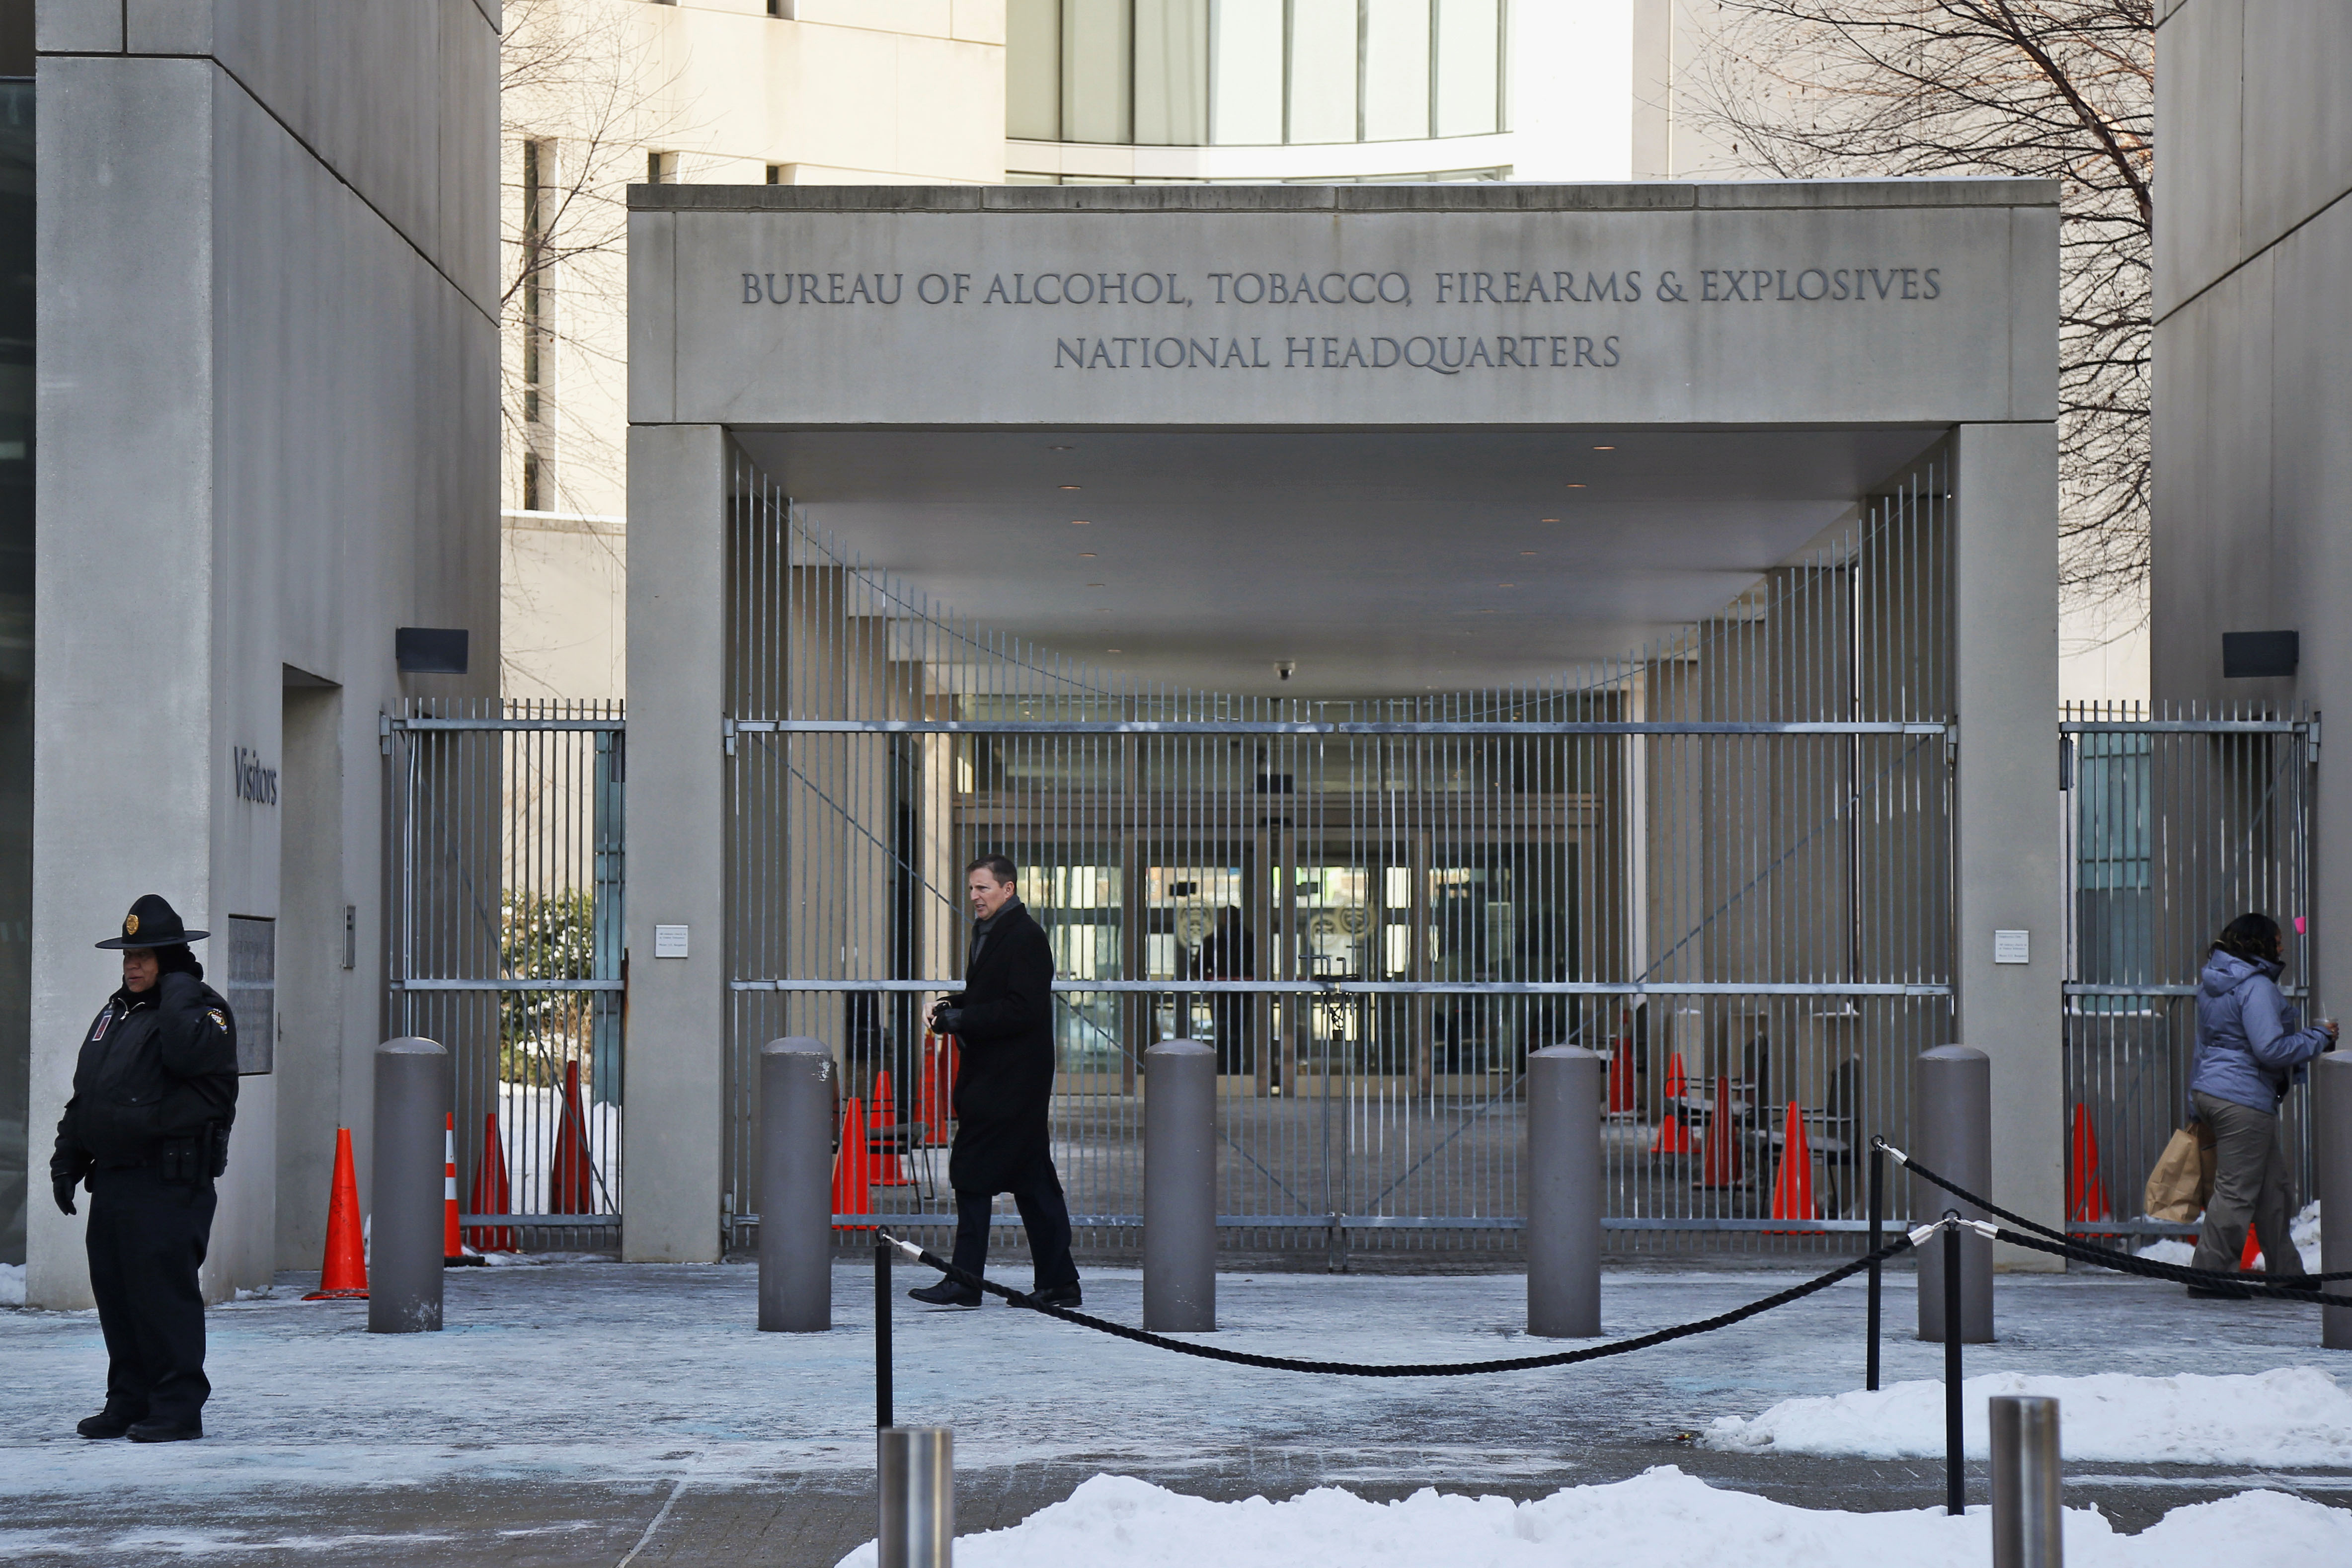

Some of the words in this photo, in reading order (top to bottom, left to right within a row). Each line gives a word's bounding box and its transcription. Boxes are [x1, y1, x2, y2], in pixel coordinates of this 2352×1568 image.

[741, 272, 904, 306] BUREAU
[917, 273, 972, 305] OF
[982, 272, 1194, 309] ALCOHOL,
[1207, 271, 1413, 308] TOBACCO,
[1434, 270, 1642, 305] FIREARMS
[1656, 270, 1689, 304] &
[1699, 267, 1941, 303] EXPLOSIVES
[1053, 337, 1271, 370] NATIONAL
[1284, 335, 1621, 377] HEADQUARTERS
[234, 746, 277, 806] Visitors
